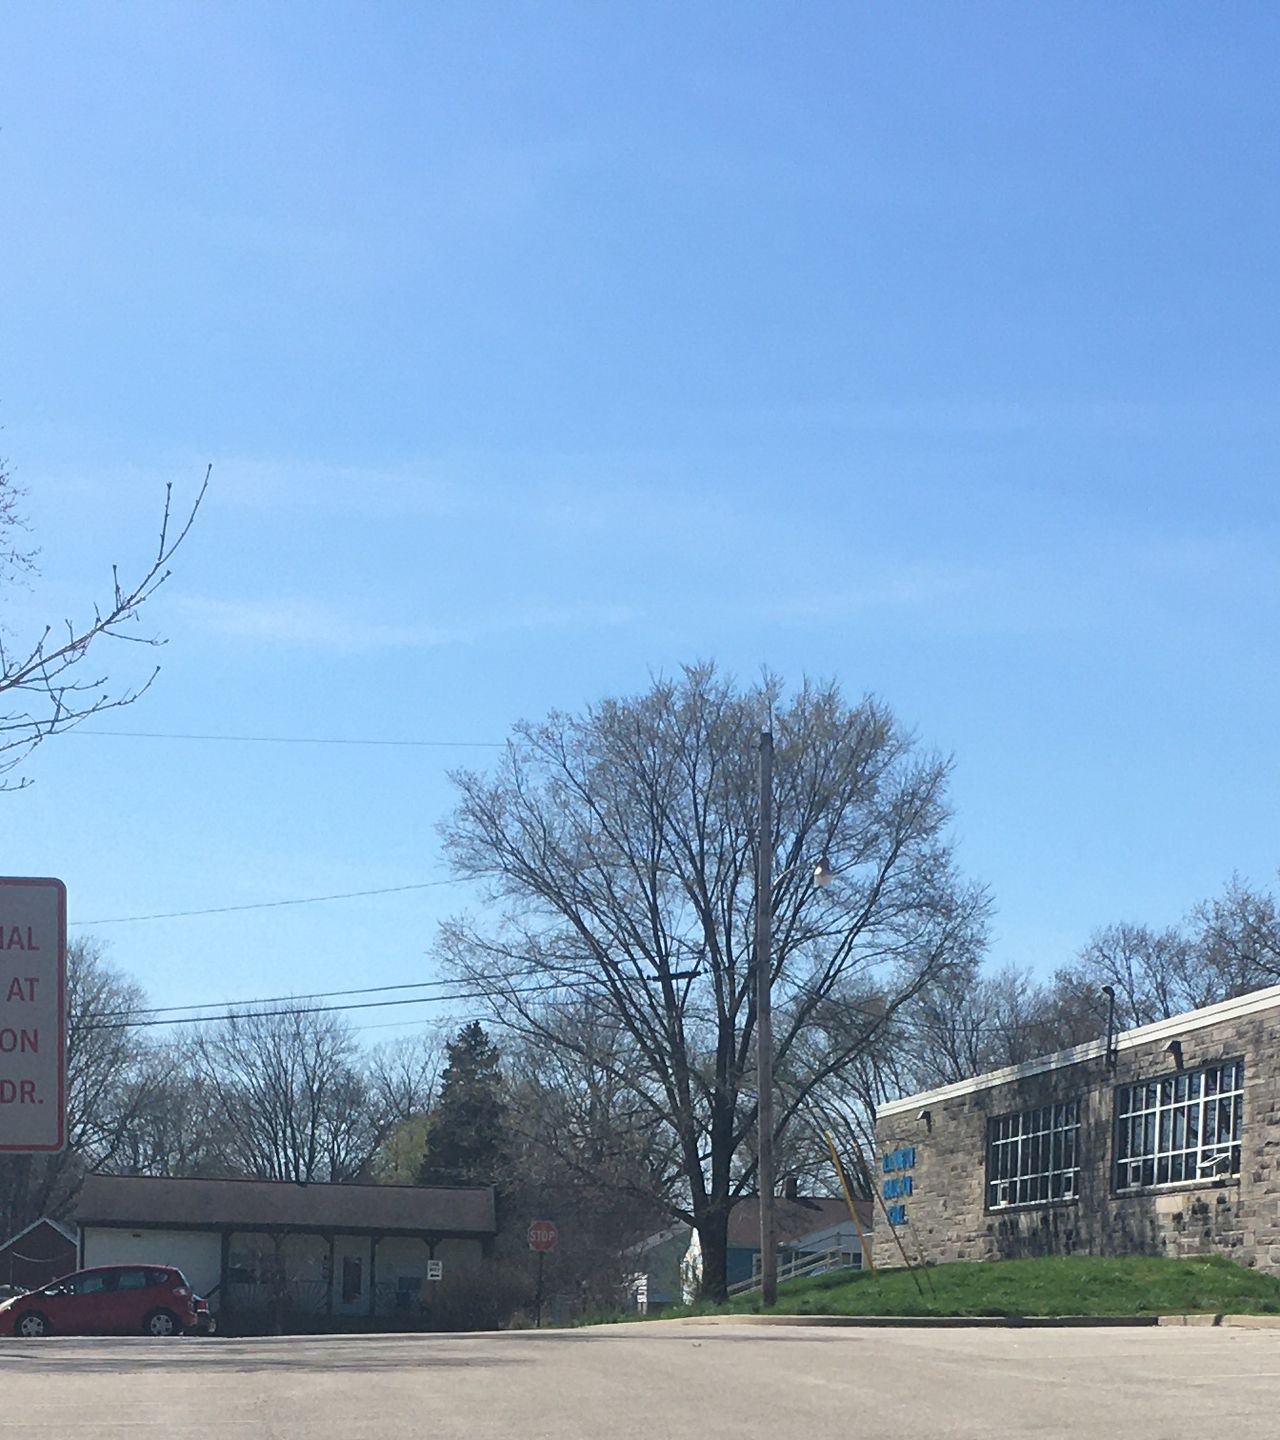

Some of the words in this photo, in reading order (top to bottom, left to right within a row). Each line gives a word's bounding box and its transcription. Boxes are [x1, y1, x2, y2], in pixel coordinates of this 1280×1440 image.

[7, 977, 40, 1002] AT
[0, 1079, 45, 1104] DR.
[529, 1230, 555, 1241] STOP
